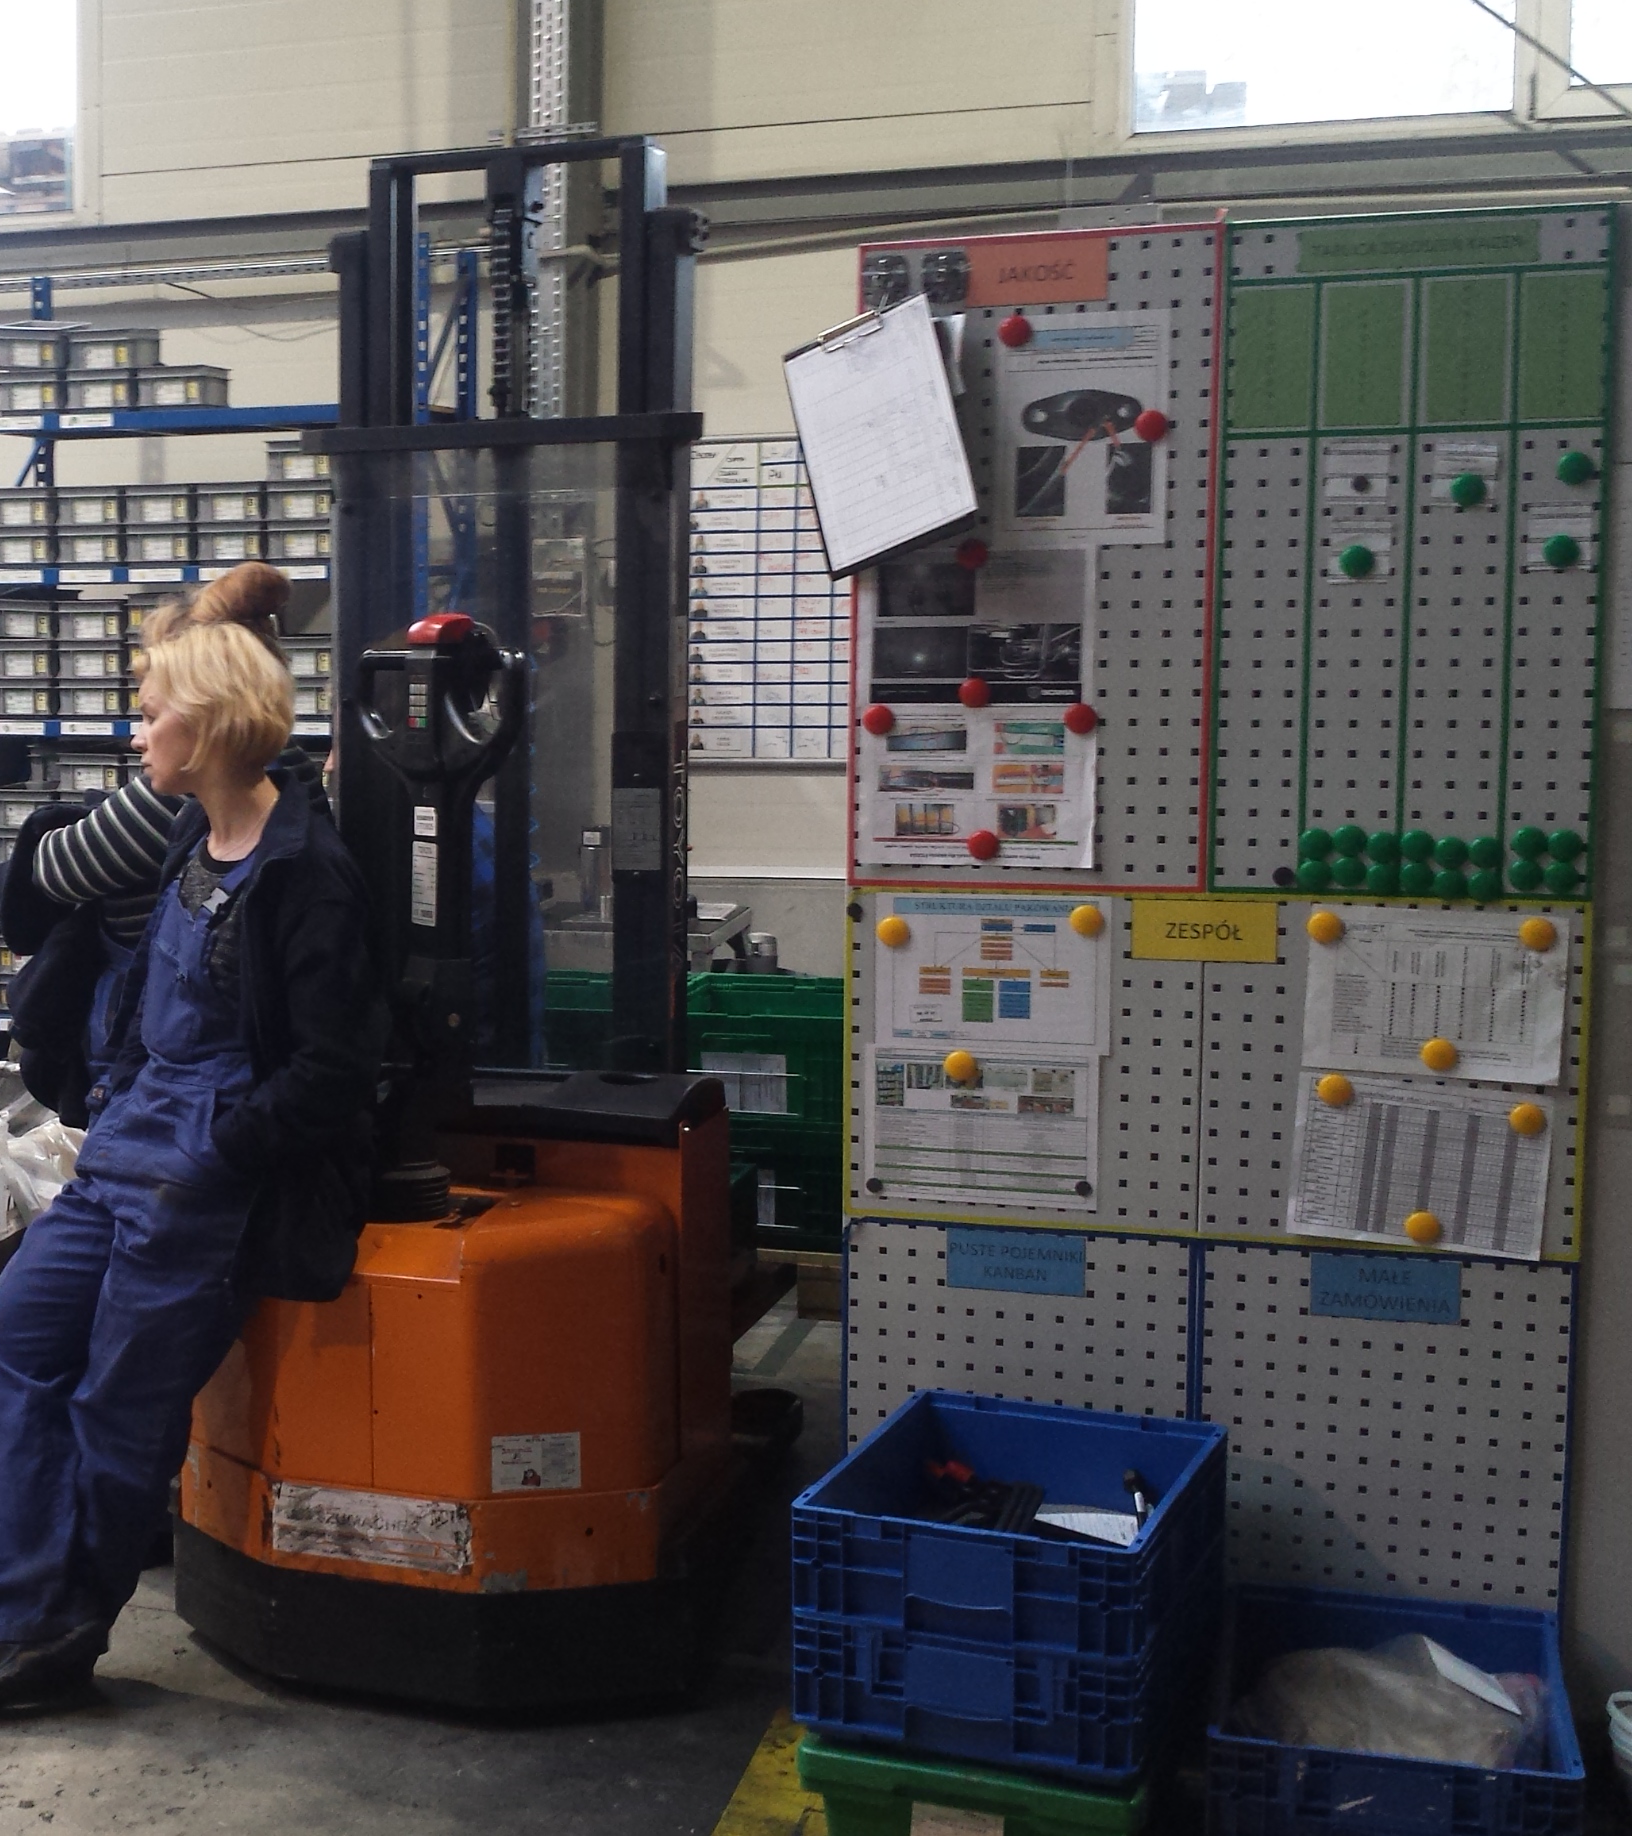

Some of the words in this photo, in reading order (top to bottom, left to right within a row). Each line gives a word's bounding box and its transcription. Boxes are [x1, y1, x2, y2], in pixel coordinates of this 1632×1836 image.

[998, 259, 1077, 284] JAKOŚĆ
[1165, 920, 1243, 941] ZESPÓŁ
[949, 1242, 996, 1257] PUSTE
[1000, 1245, 1084, 1263] POJEMNIKI
[983, 1266, 1047, 1282] KANBAN
[1358, 1267, 1412, 1285] MAŁE
